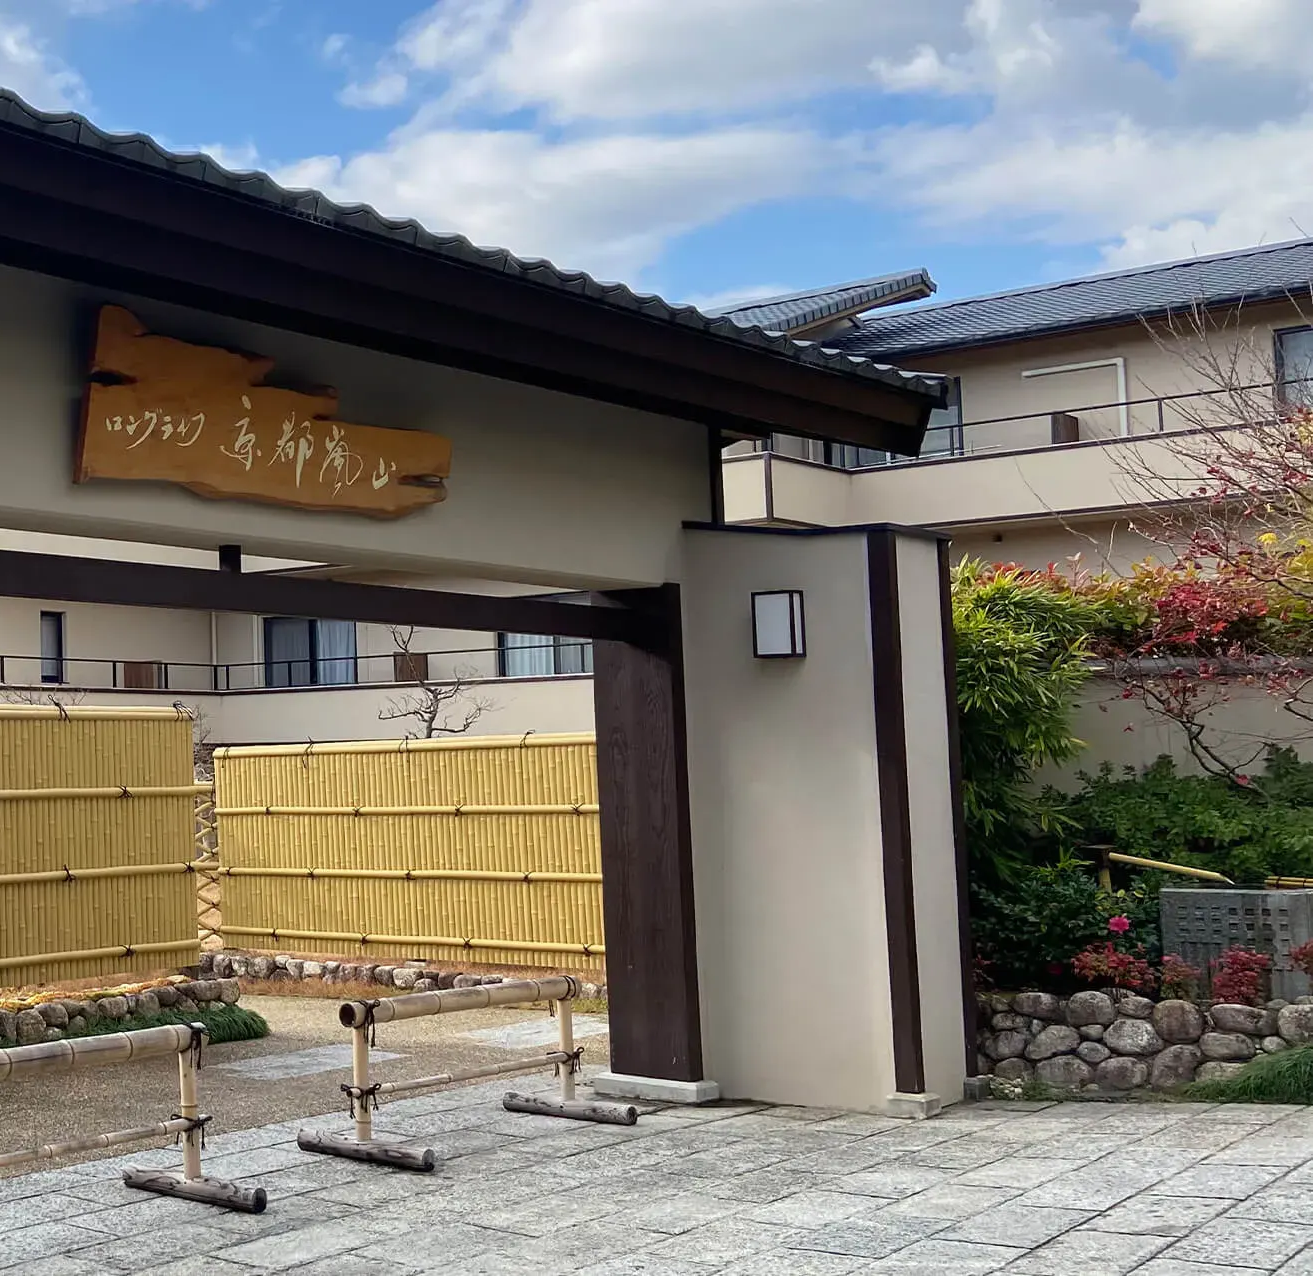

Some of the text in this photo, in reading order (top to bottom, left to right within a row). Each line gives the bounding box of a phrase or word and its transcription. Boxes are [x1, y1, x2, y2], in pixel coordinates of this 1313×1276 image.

[105, 395, 397, 498] ロングライフ 京都嵐山
